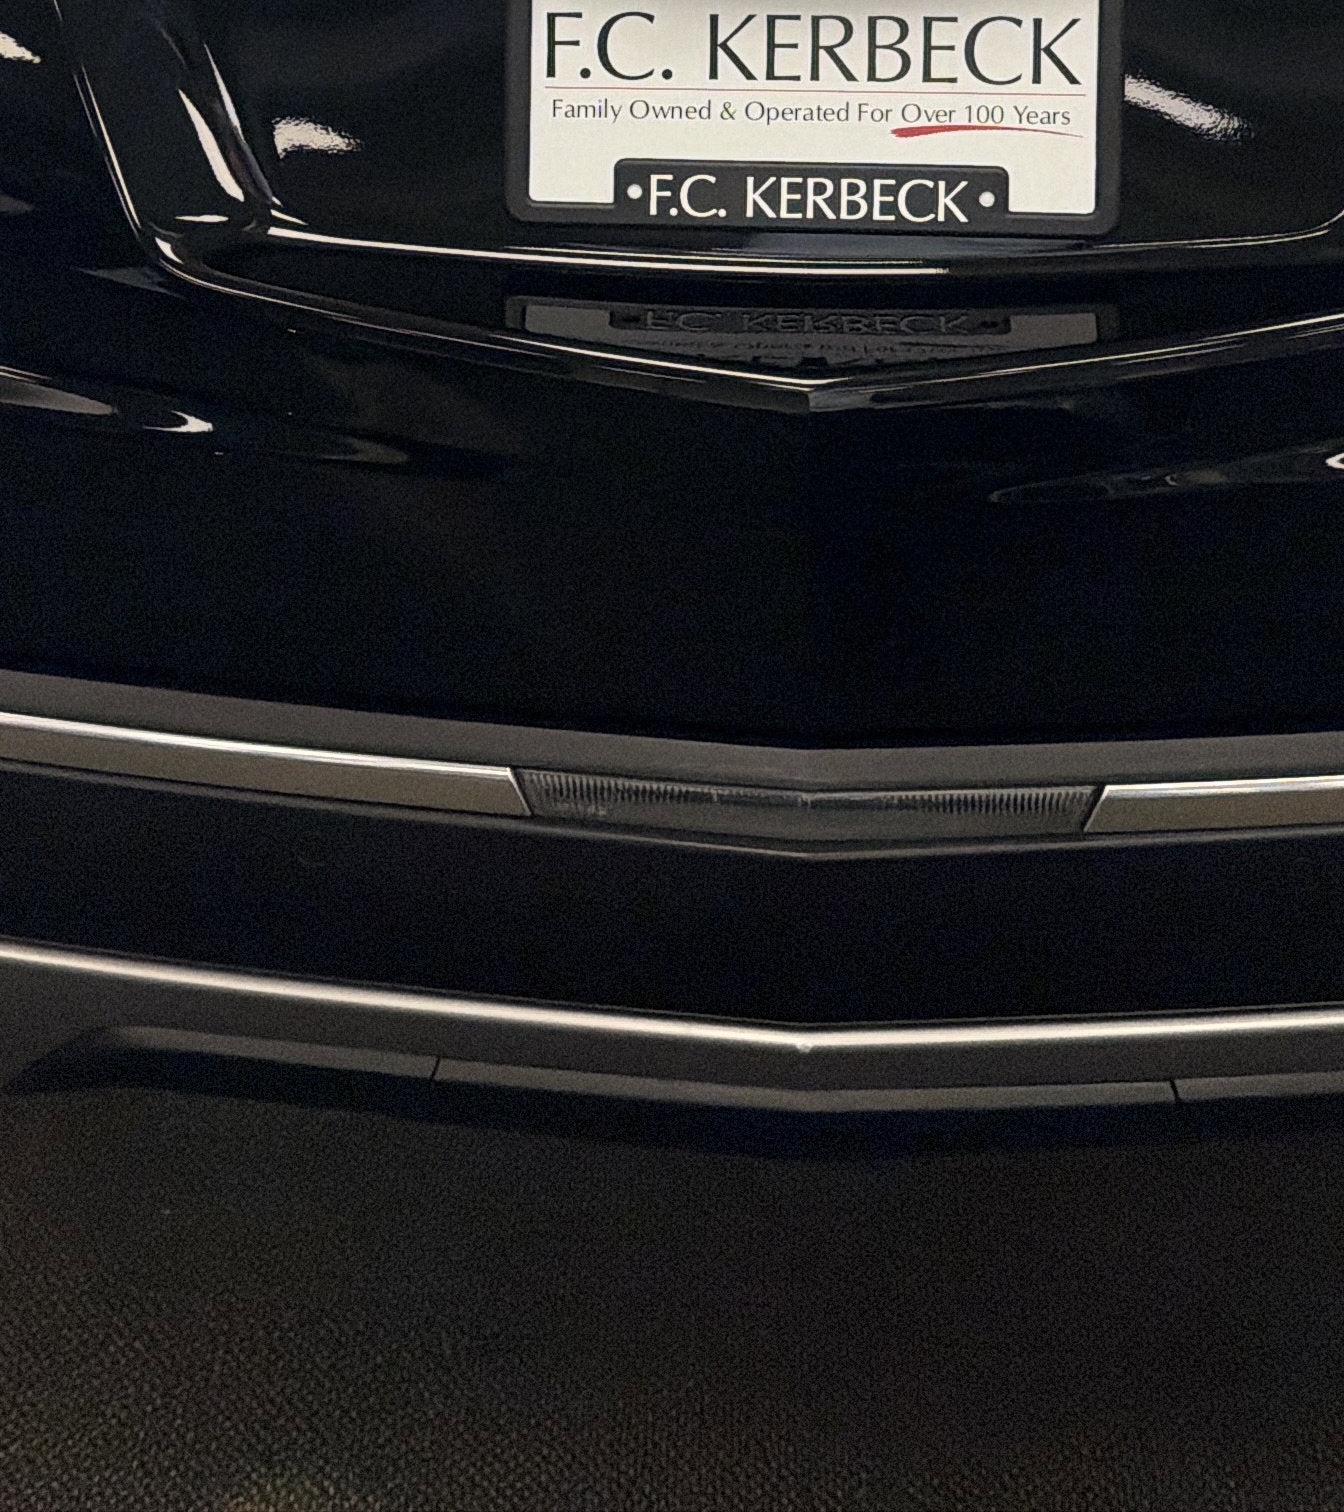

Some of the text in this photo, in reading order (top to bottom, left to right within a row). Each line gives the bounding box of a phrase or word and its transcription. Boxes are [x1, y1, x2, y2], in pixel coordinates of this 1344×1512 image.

[545, 11, 1083, 86] F.C. KERBECK
[552, 98, 1071, 125] Family Owned & Operated For Over 100 Years
[648, 174, 969, 223] F.C. KERBECK
